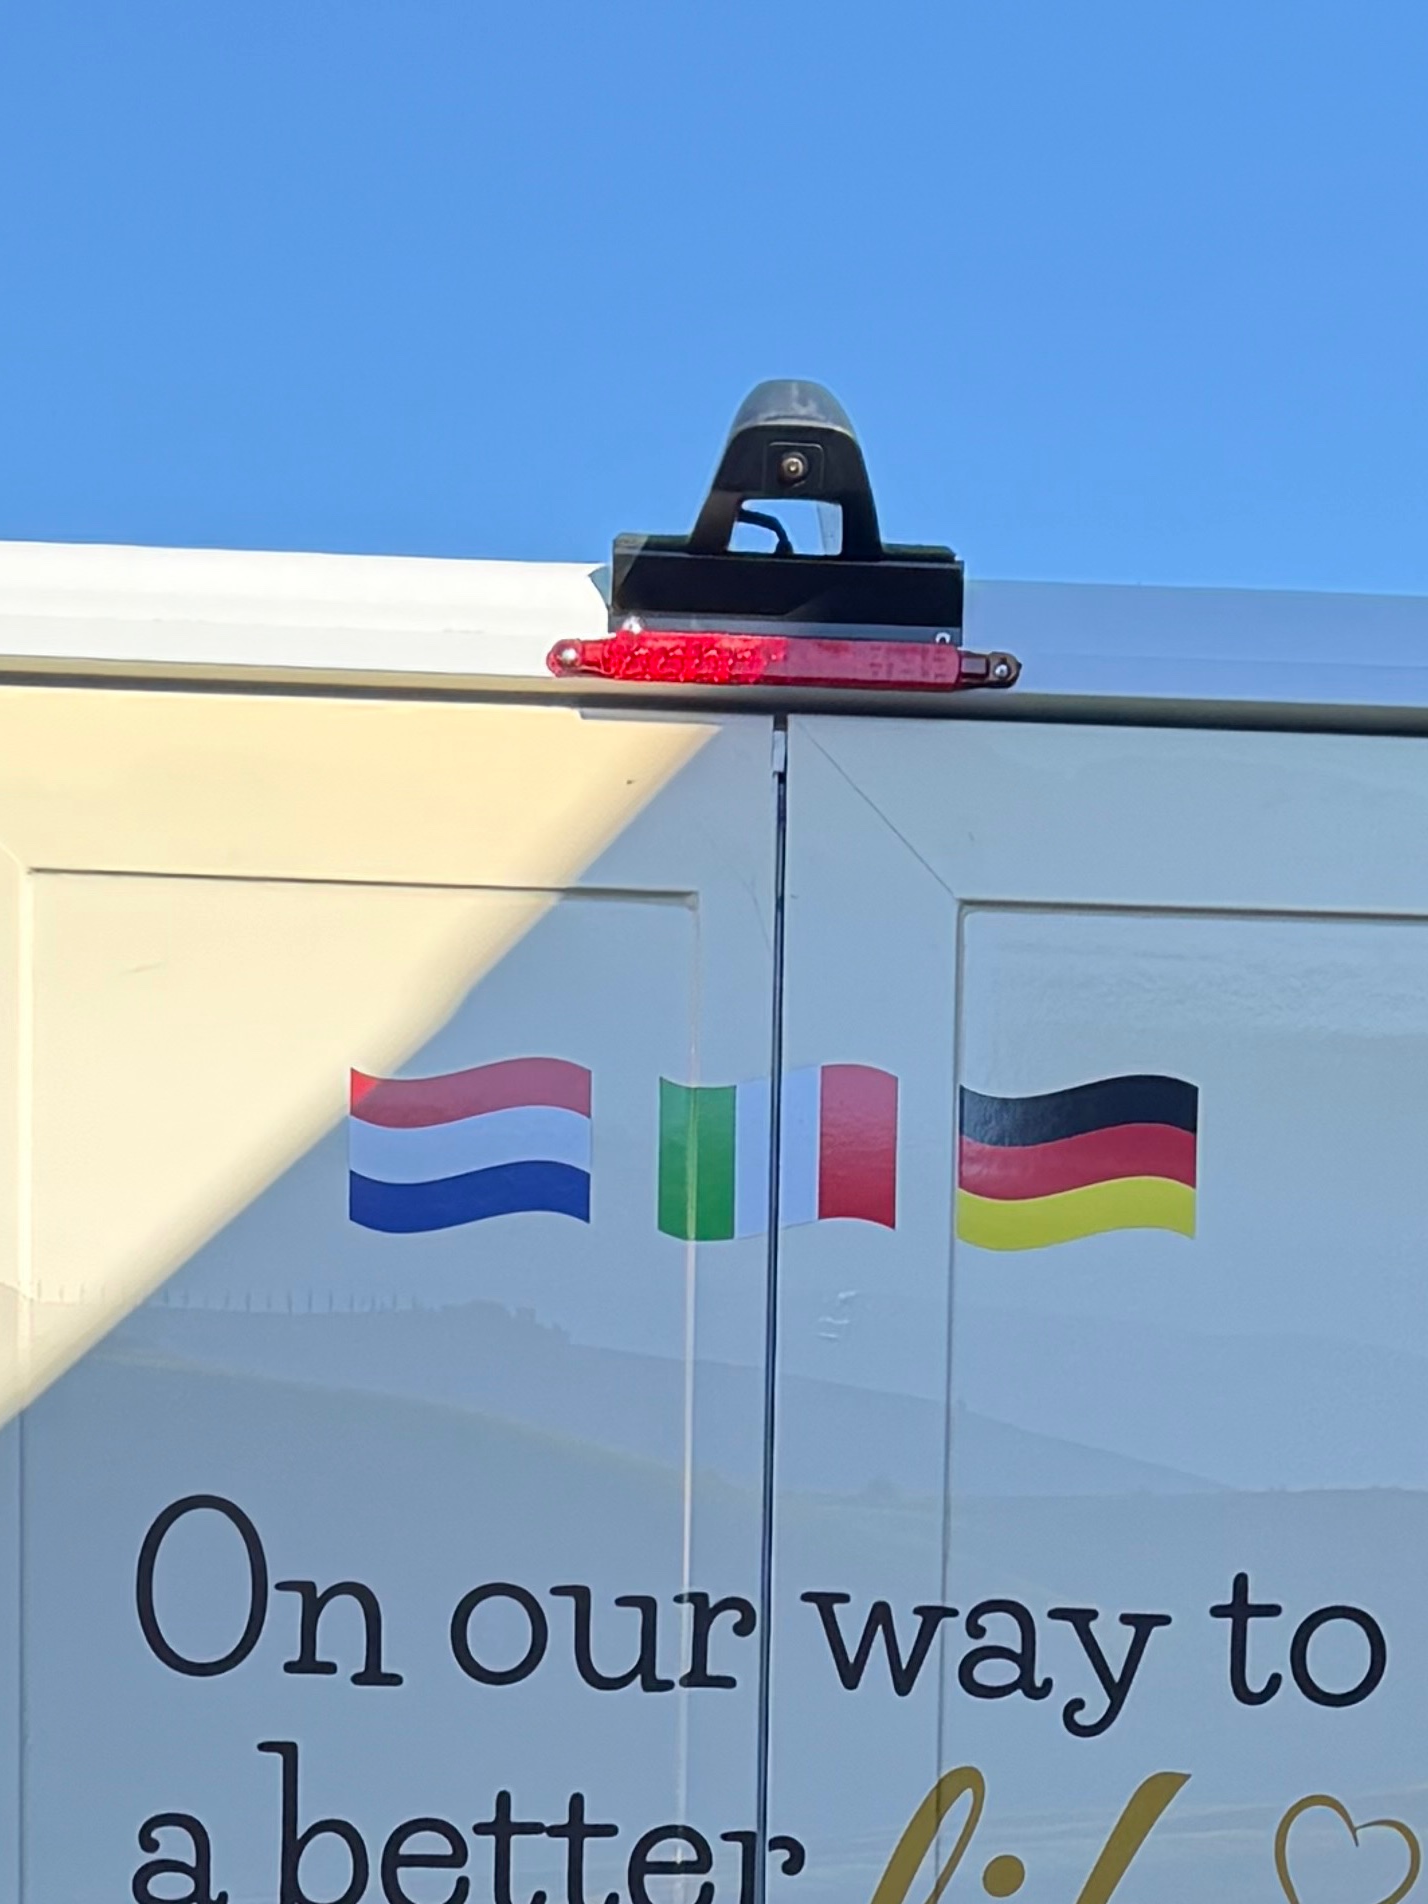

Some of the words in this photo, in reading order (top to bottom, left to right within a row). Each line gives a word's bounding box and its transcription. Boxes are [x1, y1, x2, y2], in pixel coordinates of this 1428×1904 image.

[134, 1494, 403, 1689] On
[449, 1580, 757, 1693] our
[801, 1591, 1171, 1738] way
[1209, 1572, 1388, 1708] to
